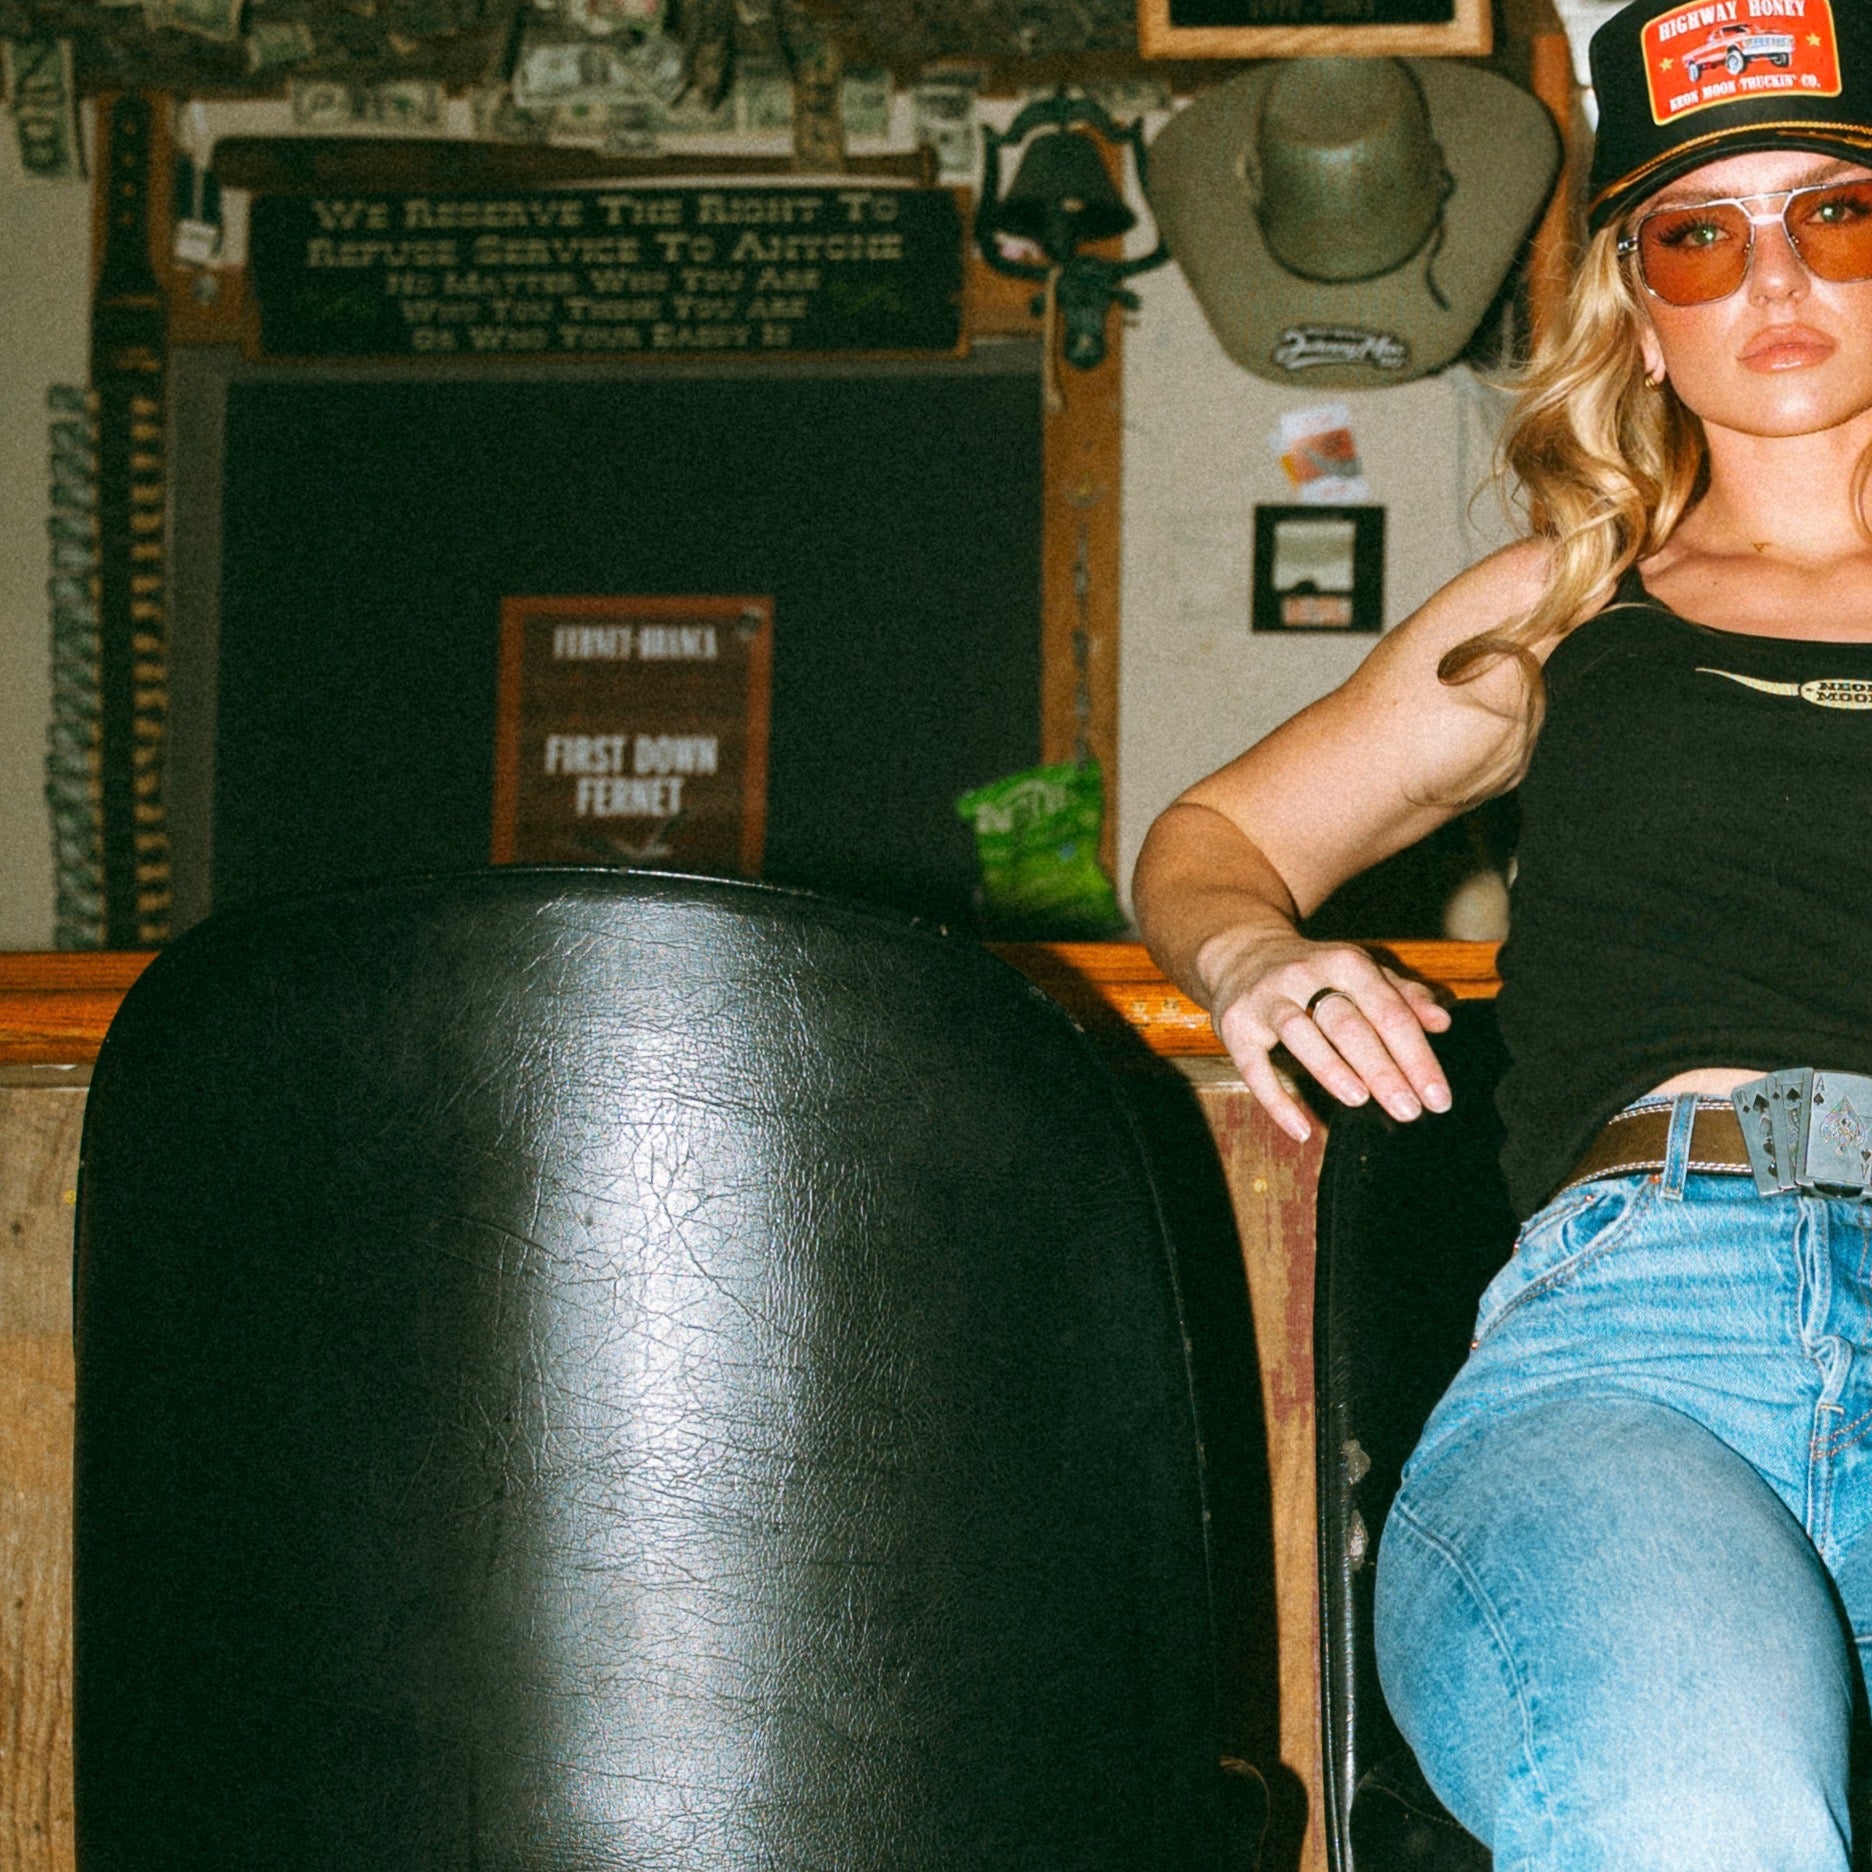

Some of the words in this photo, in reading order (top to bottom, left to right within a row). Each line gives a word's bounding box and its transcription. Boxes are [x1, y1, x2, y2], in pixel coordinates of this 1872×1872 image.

[1658, 0, 1738, 42] HIGHWAY
[1669, 91, 1700, 113] NEON
[1702, 80, 1737, 100] MOON
[1800, 73, 1822, 89] CO.
[544, 734, 627, 778] FIRST
[633, 733, 719, 777] DOWN
[574, 776, 686, 819] FERNET
